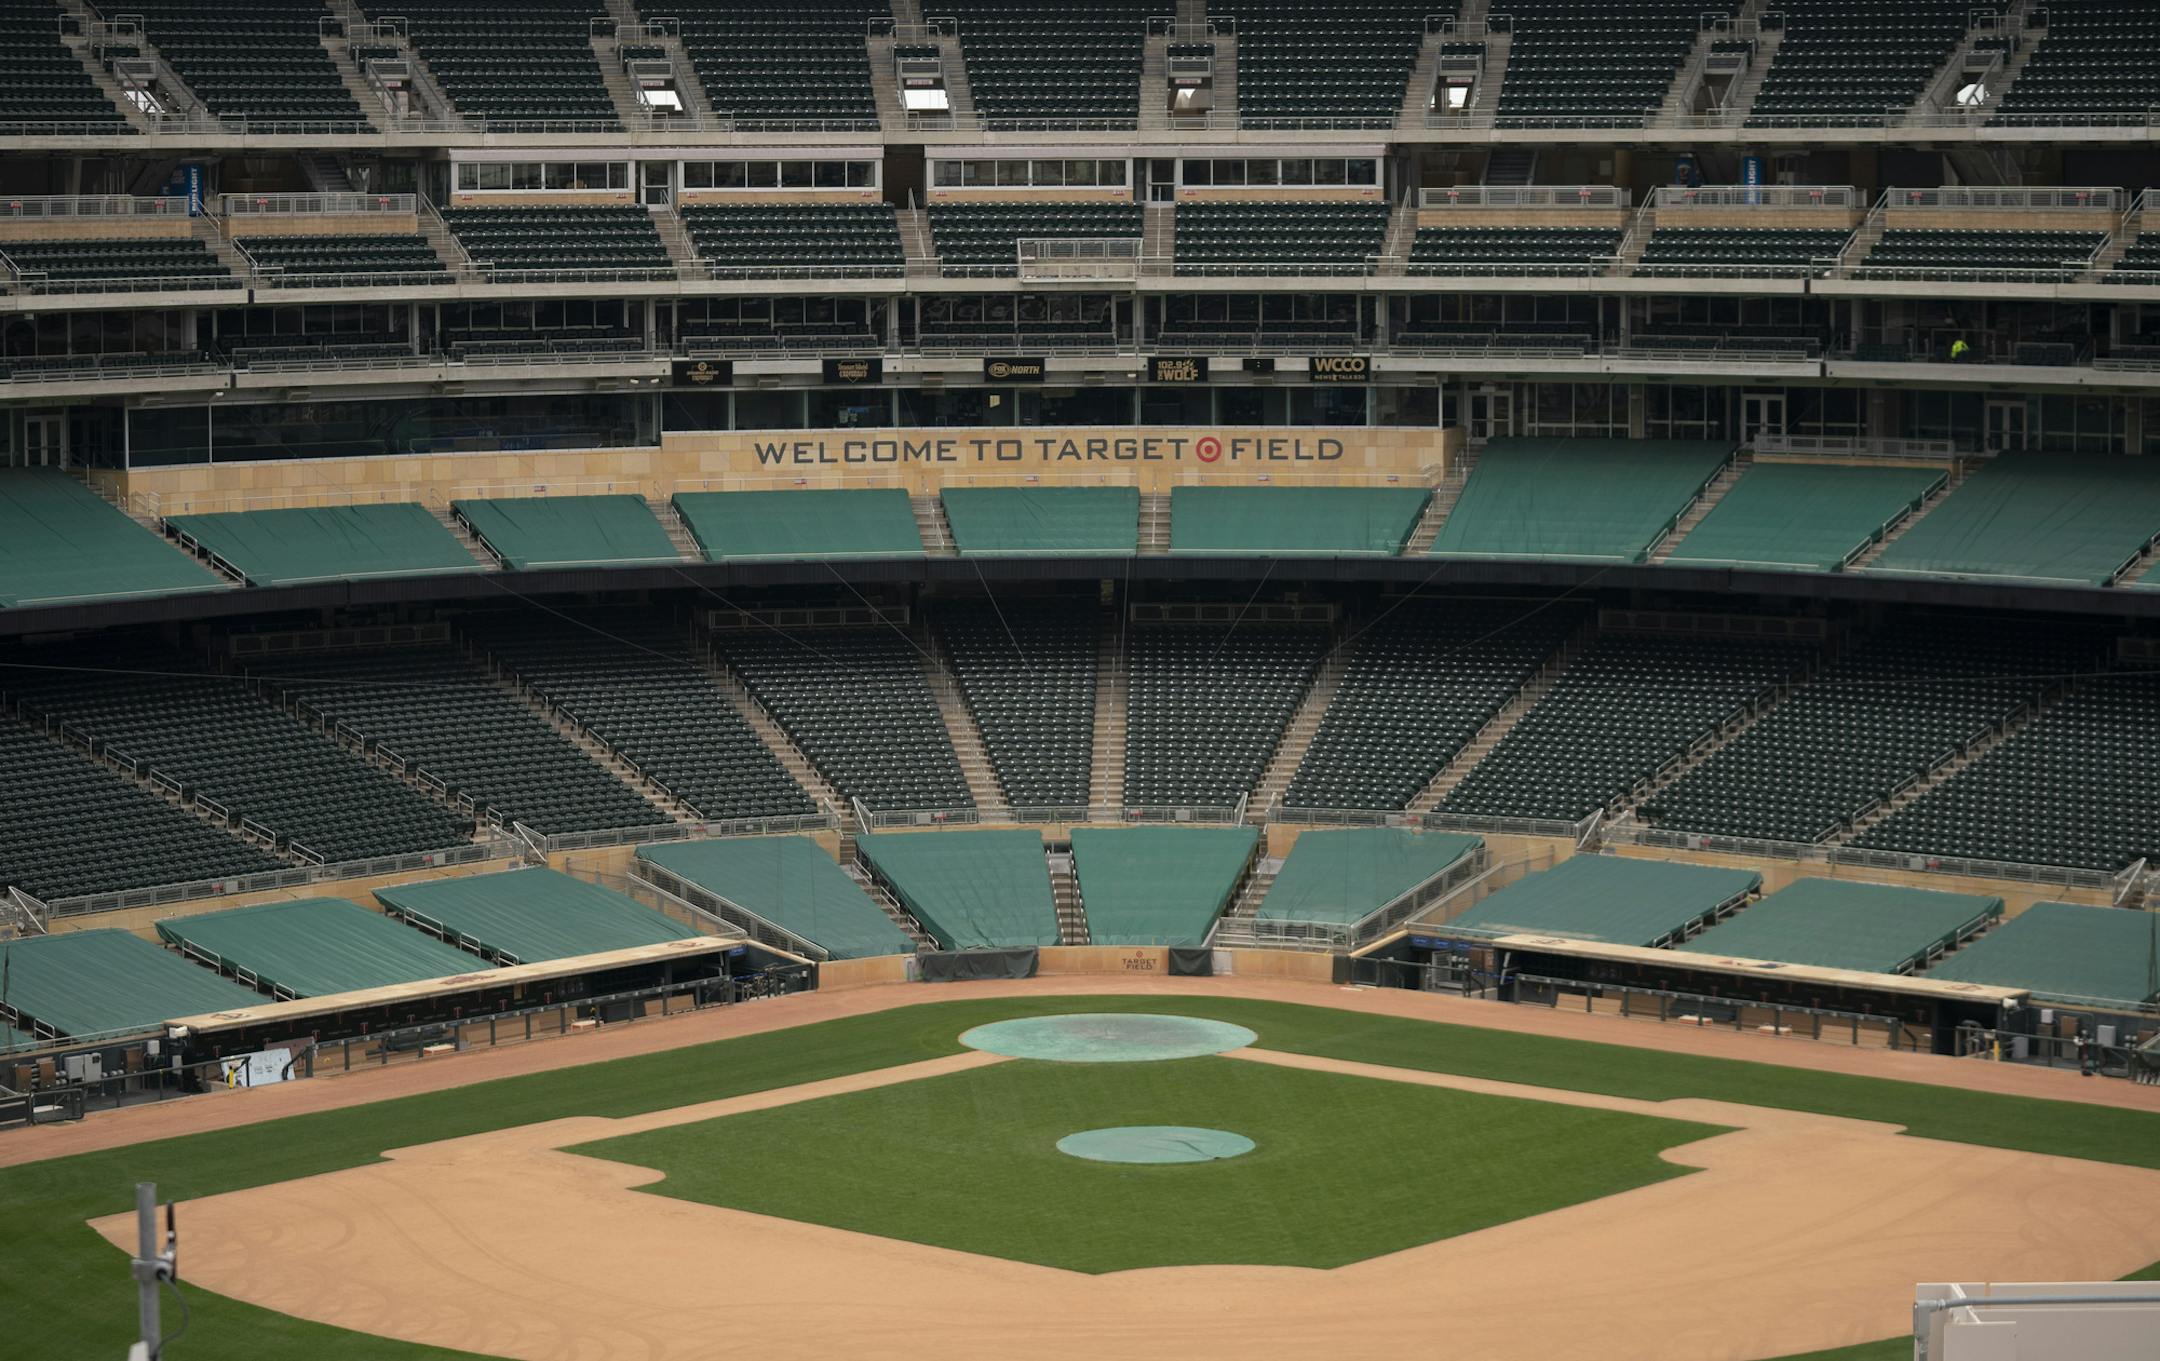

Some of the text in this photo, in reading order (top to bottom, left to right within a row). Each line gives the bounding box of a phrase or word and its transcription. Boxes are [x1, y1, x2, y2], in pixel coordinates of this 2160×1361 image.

[1748, 159, 1756, 183] LIGHT
[1011, 365, 1040, 375] NORTH
[1158, 361, 1183, 369] 102.9
[1314, 358, 1365, 372] WCCO
[1164, 367, 1199, 381] WOLF
[754, 438, 1344, 465] WELCOME TO TARGET FIELD
